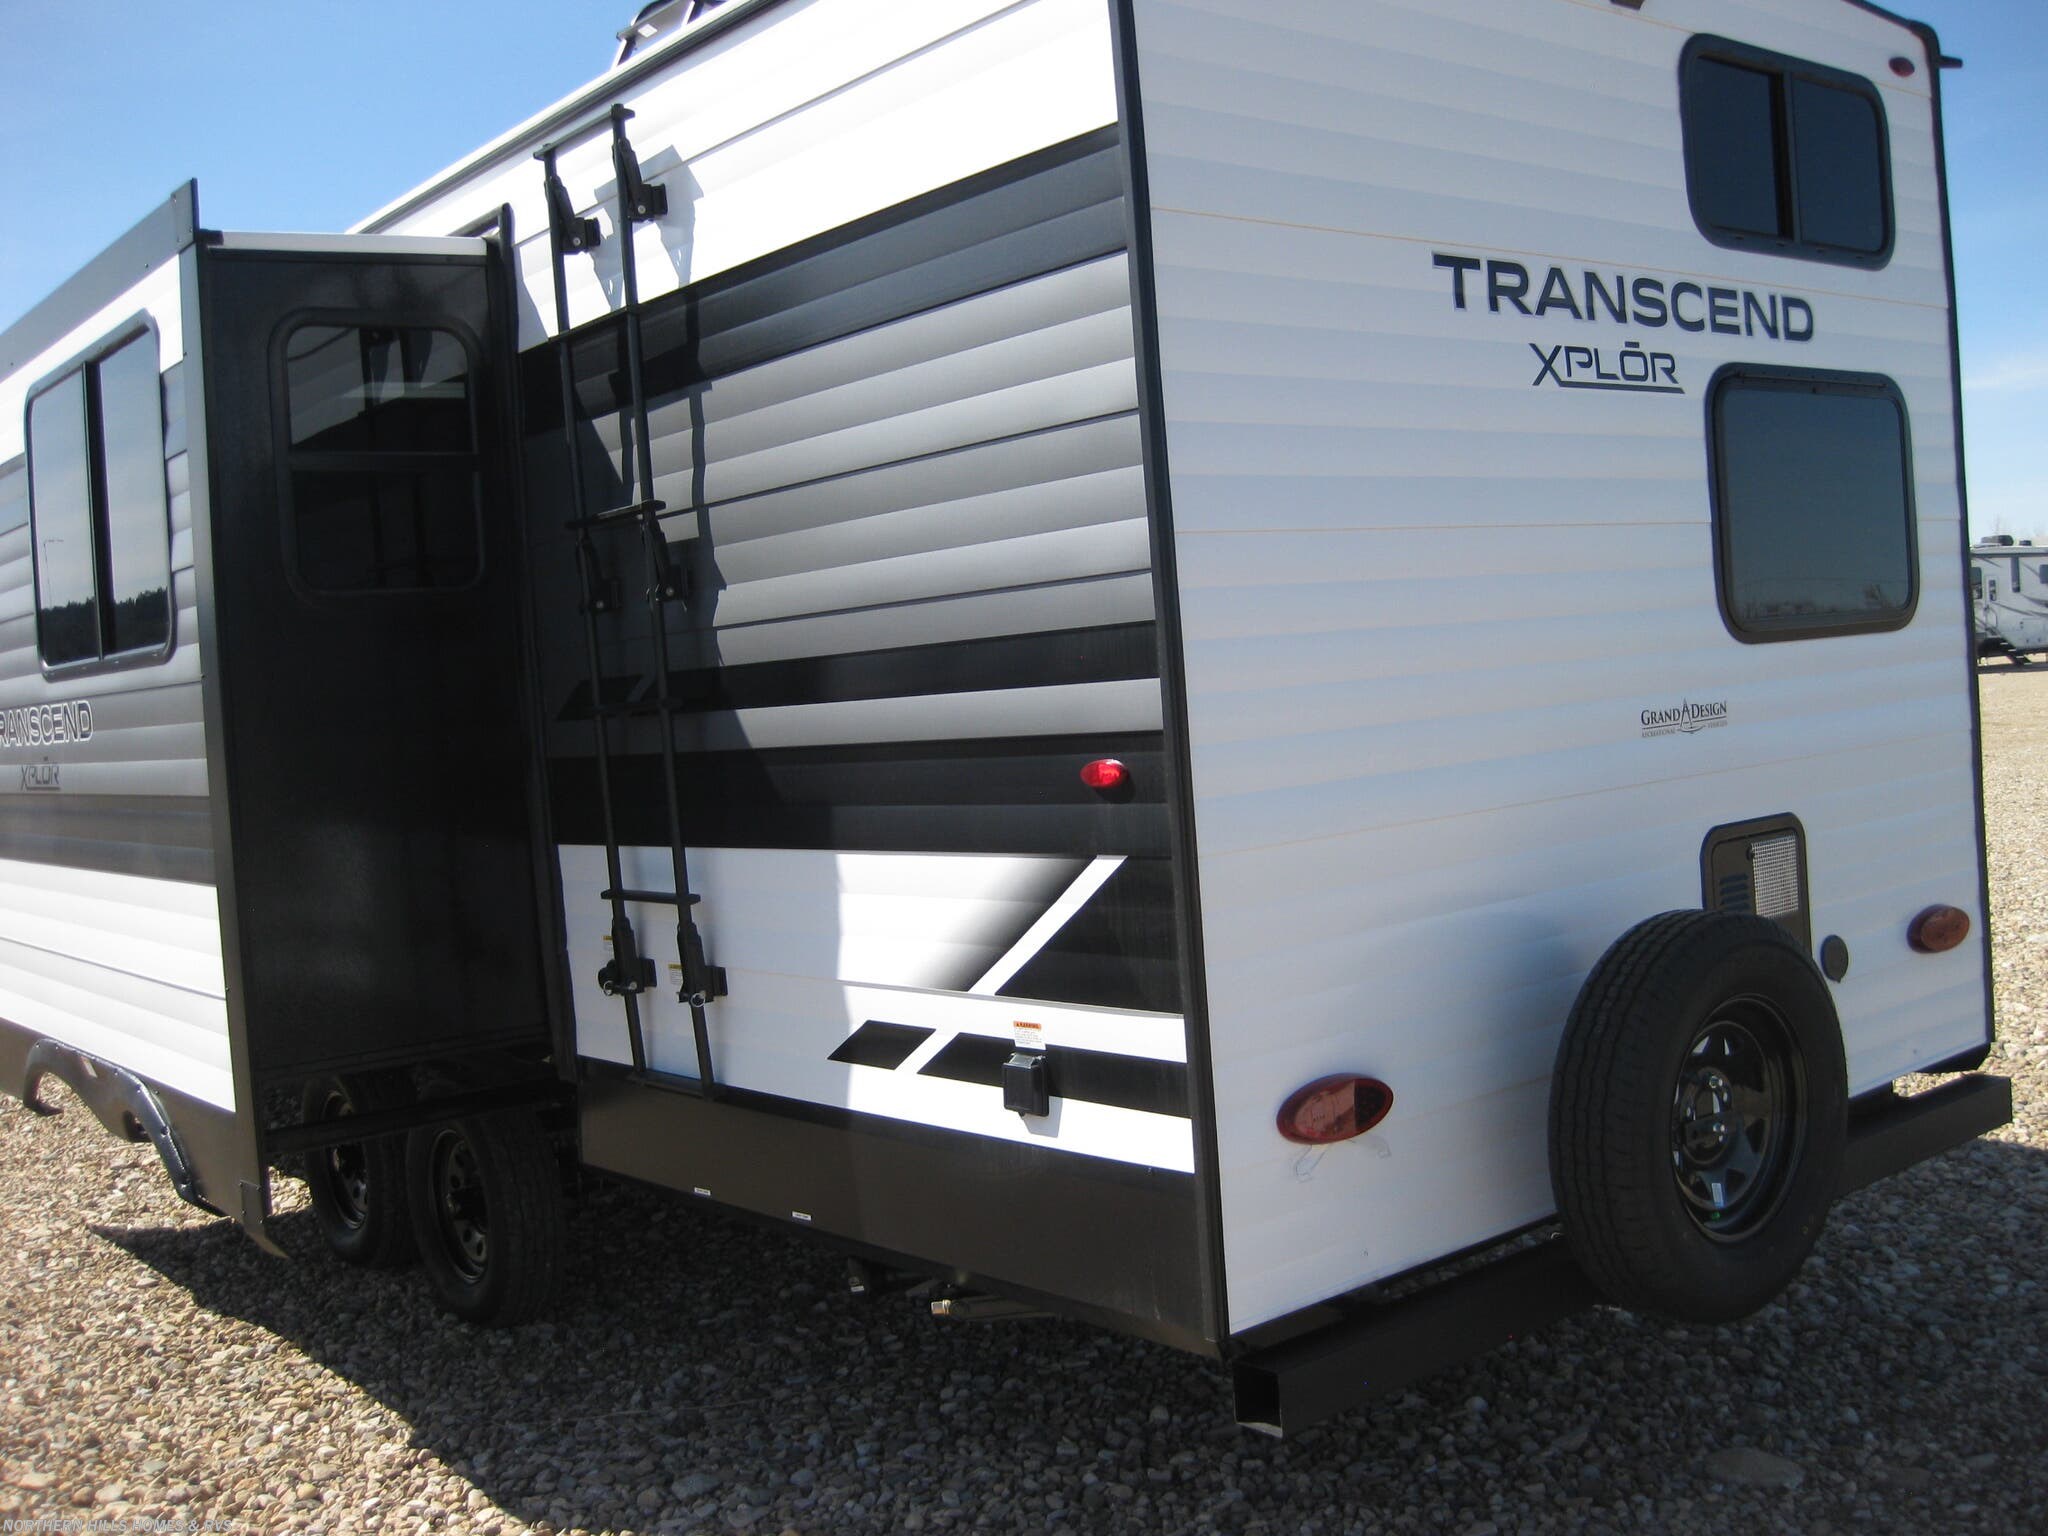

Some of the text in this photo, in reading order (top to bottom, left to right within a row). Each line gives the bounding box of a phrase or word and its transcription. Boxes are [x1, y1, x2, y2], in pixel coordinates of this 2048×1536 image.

[1432, 252, 1815, 342] TRANSCEND
[0, 700, 94, 747] RANSCEND
[1641, 700, 1727, 726] GRAND DESIGN
